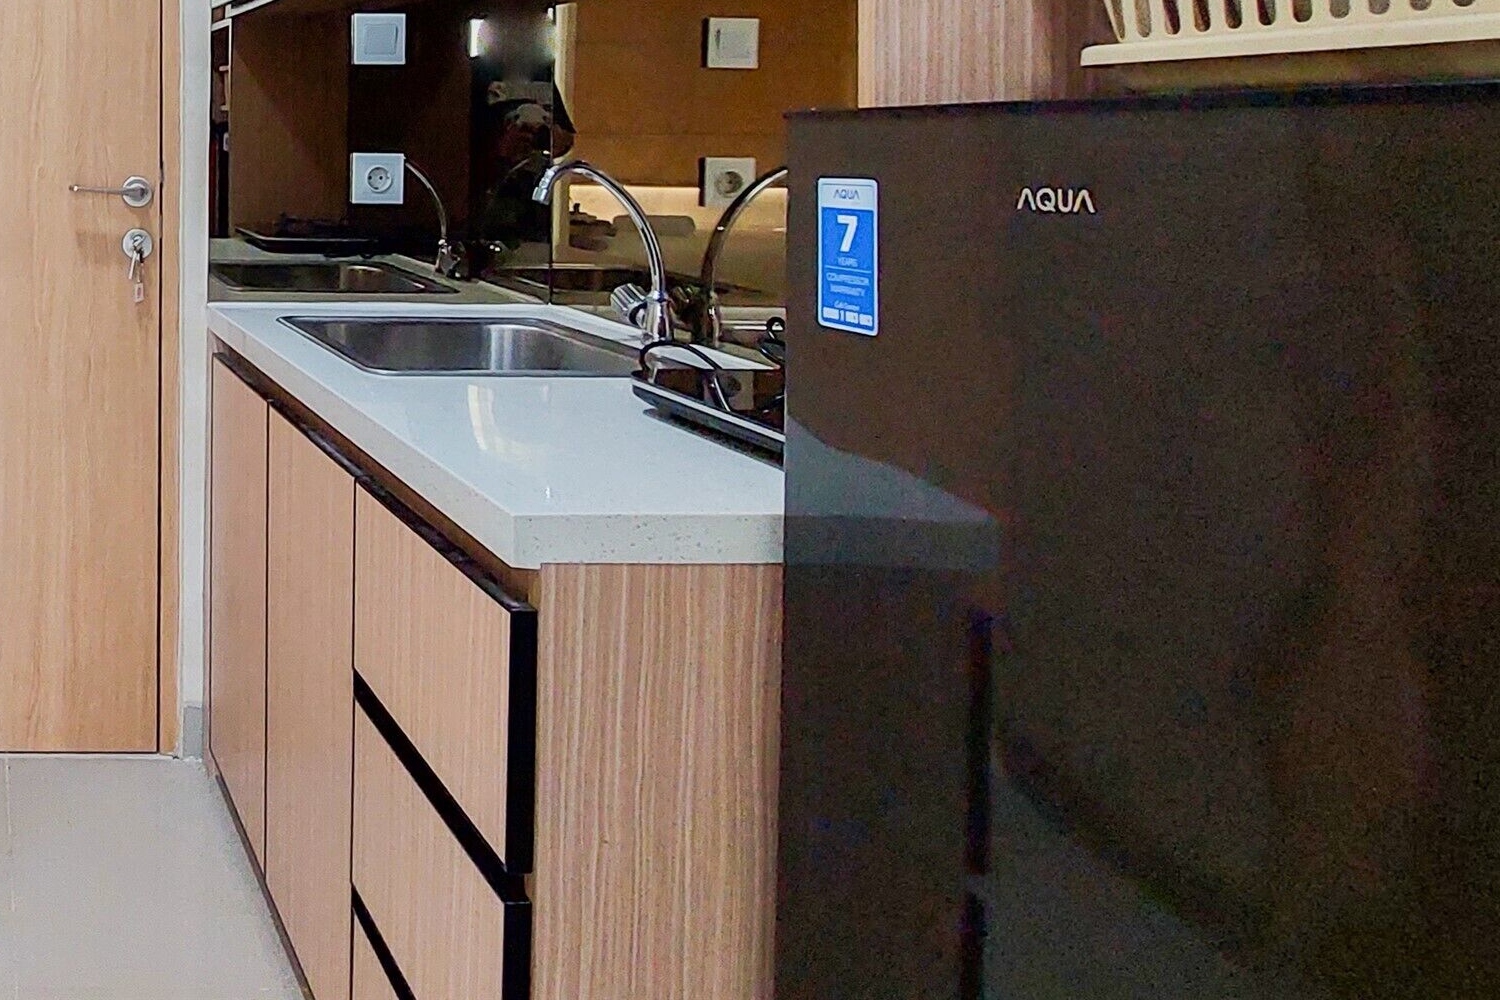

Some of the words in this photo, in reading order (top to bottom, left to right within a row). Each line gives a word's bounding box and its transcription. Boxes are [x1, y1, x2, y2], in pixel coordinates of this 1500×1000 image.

[833, 188, 860, 200] AQUA
[1017, 187, 1096, 213] AQUA
[836, 214, 858, 252] 7
